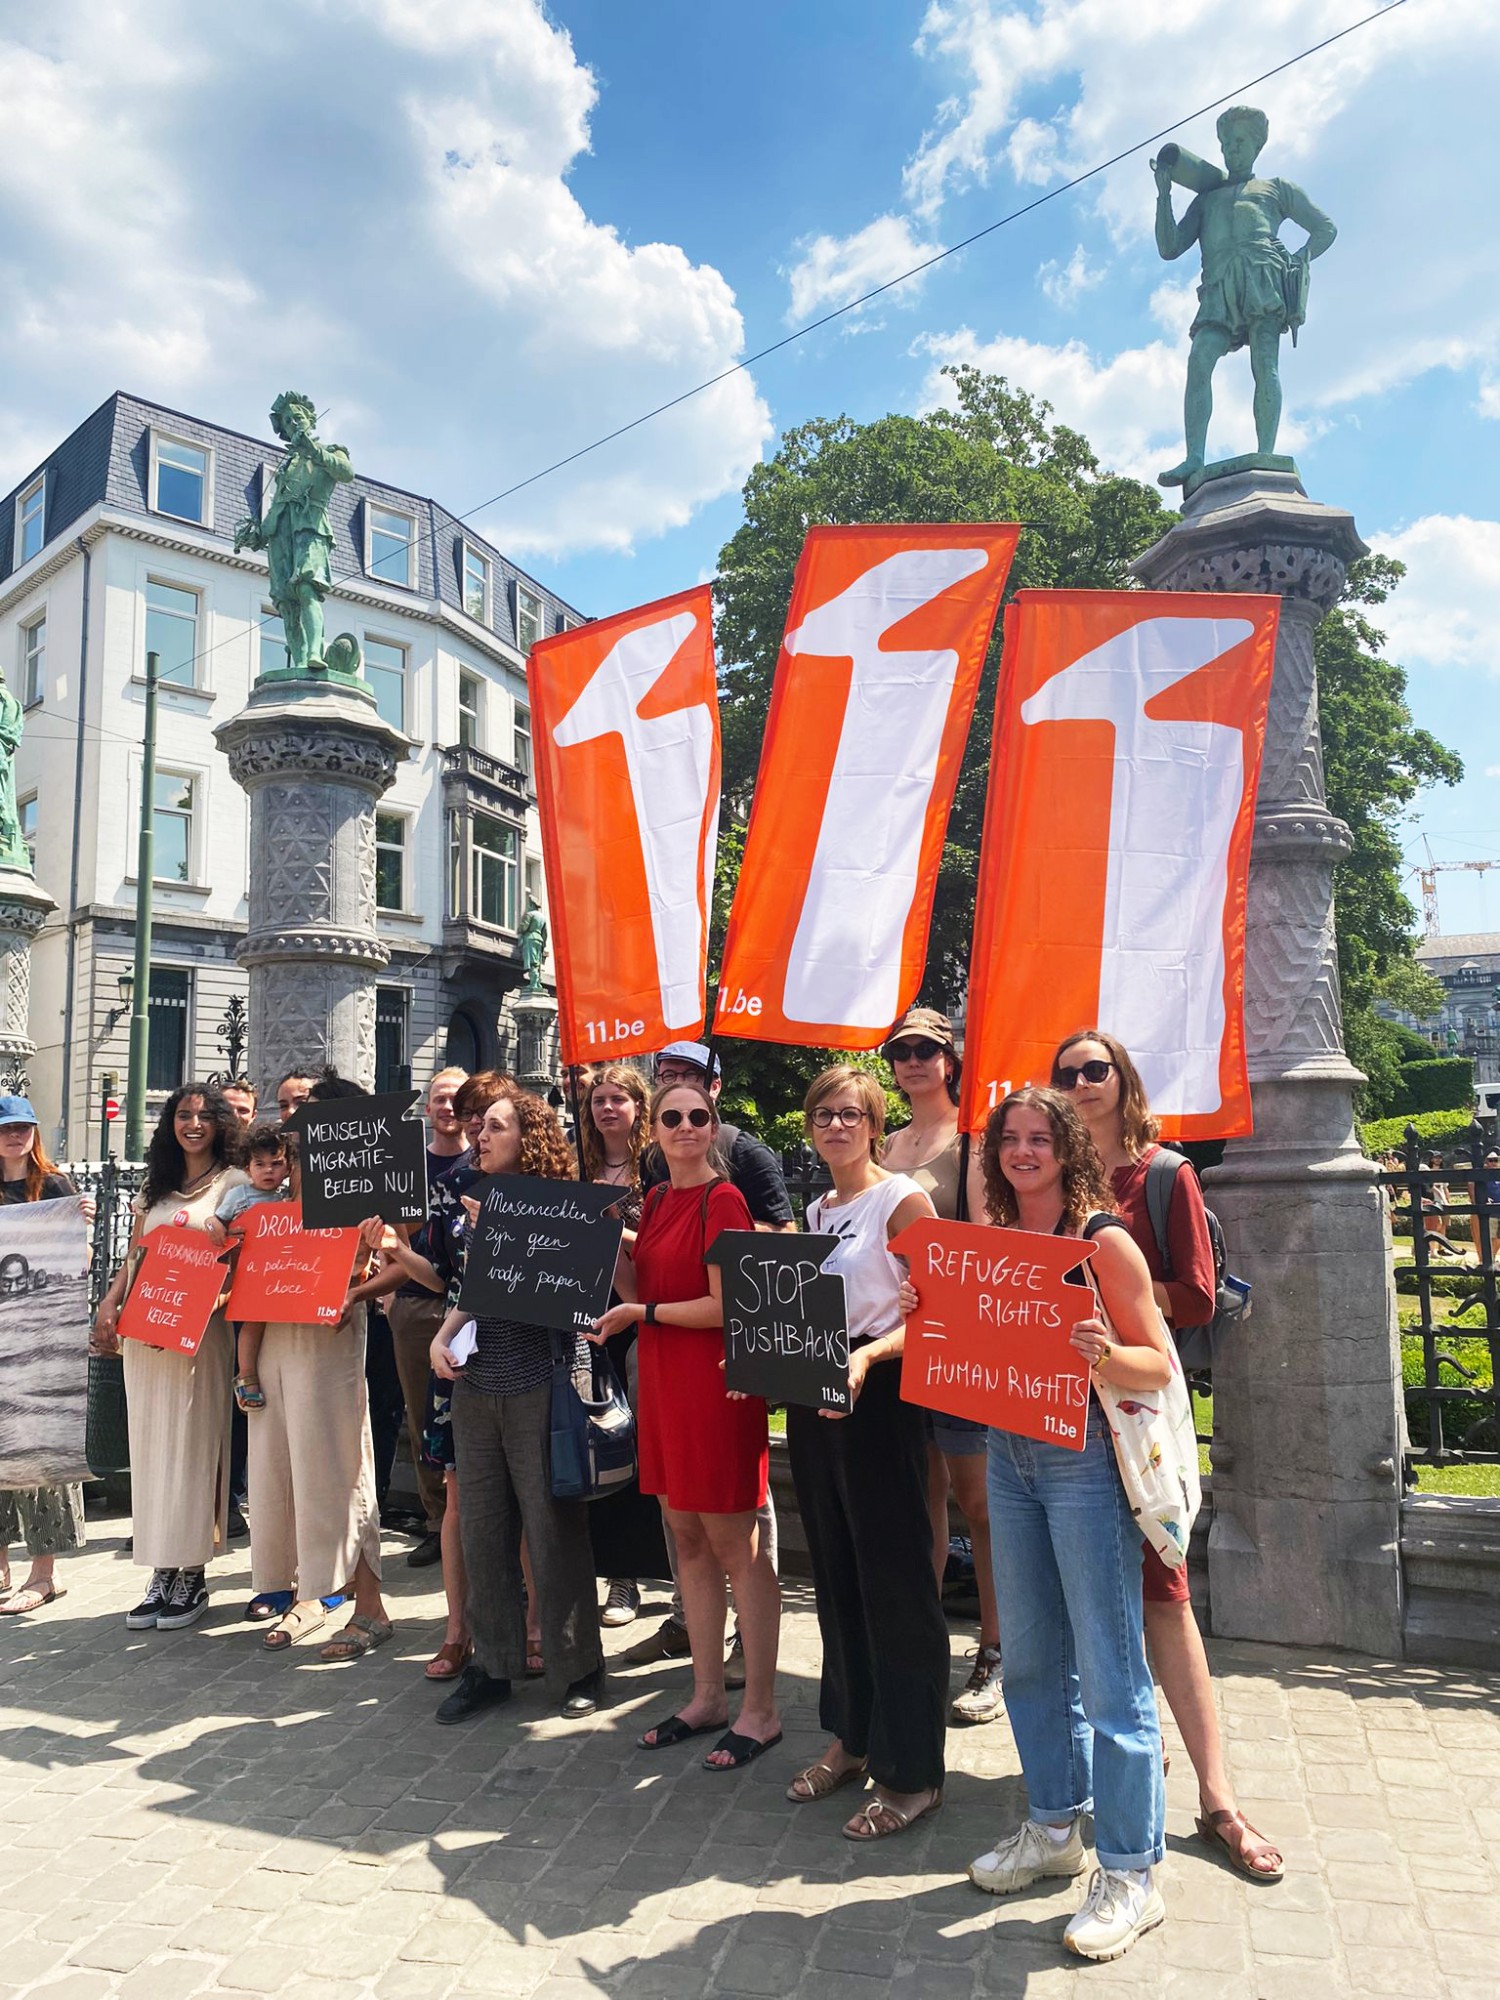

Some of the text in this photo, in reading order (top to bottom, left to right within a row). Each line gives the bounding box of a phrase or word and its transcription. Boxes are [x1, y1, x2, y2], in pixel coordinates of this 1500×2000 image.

[584, 1018, 646, 1045] 11.be
[306, 1117, 391, 1147] MENSELIJK
[384, 1170, 414, 1198] NU!
[400, 1206, 423, 1217] 11.be
[526, 1232, 571, 1258] geen
[246, 1256, 325, 1278] a political
[927, 1242, 1047, 1291] REFUGEE
[735, 1254, 818, 1320] STOP
[145, 1306, 183, 1328] KEUZE
[317, 1306, 338, 1318] 11.be
[572, 1311, 598, 1327] 11.be
[978, 1293, 1062, 1328] RIGHTS
[729, 1318, 849, 1369] PUSHBACKS
[926, 1355, 1087, 1408] HUMAN RIGHTS
[821, 1386, 846, 1404] 11.be
[1043, 1414, 1077, 1439] 11.be
